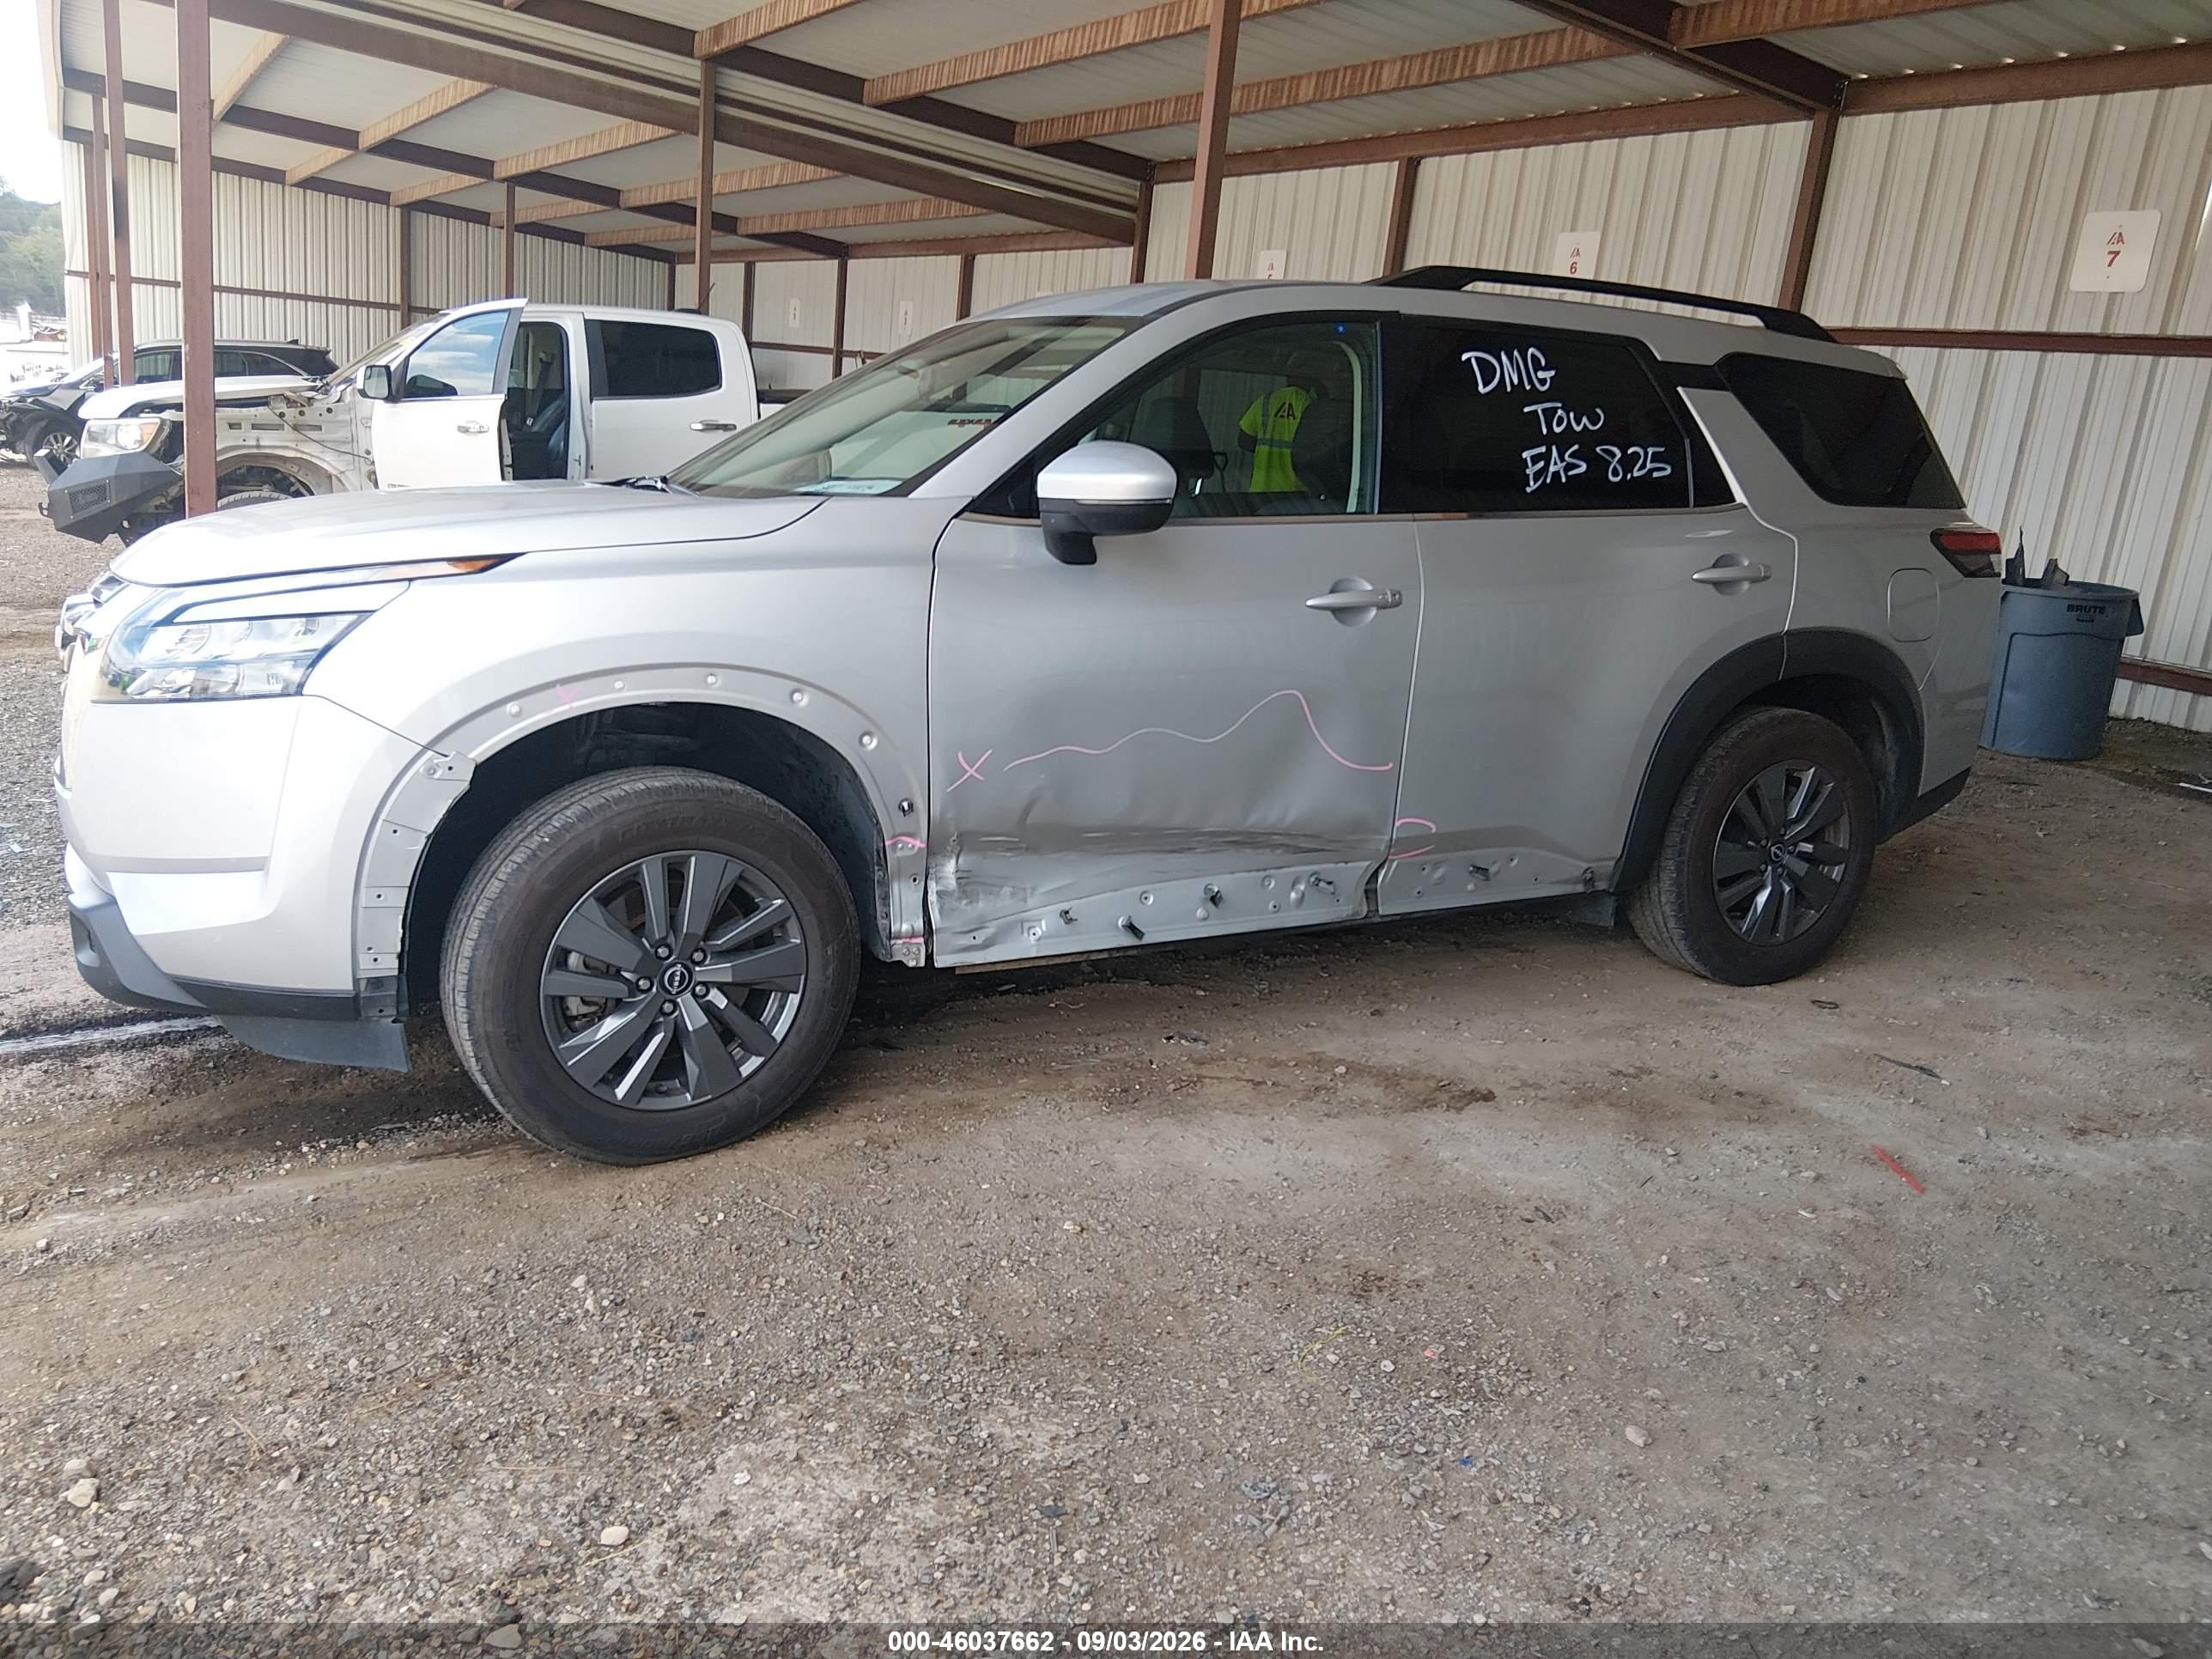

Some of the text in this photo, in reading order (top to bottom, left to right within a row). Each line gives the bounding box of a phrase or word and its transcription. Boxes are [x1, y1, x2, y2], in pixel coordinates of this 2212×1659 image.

[1570, 261, 1578, 275] 6
[2106, 250, 2121, 268] 7
[1461, 347, 1556, 395] DMG
[1522, 444, 1588, 493] EAS
